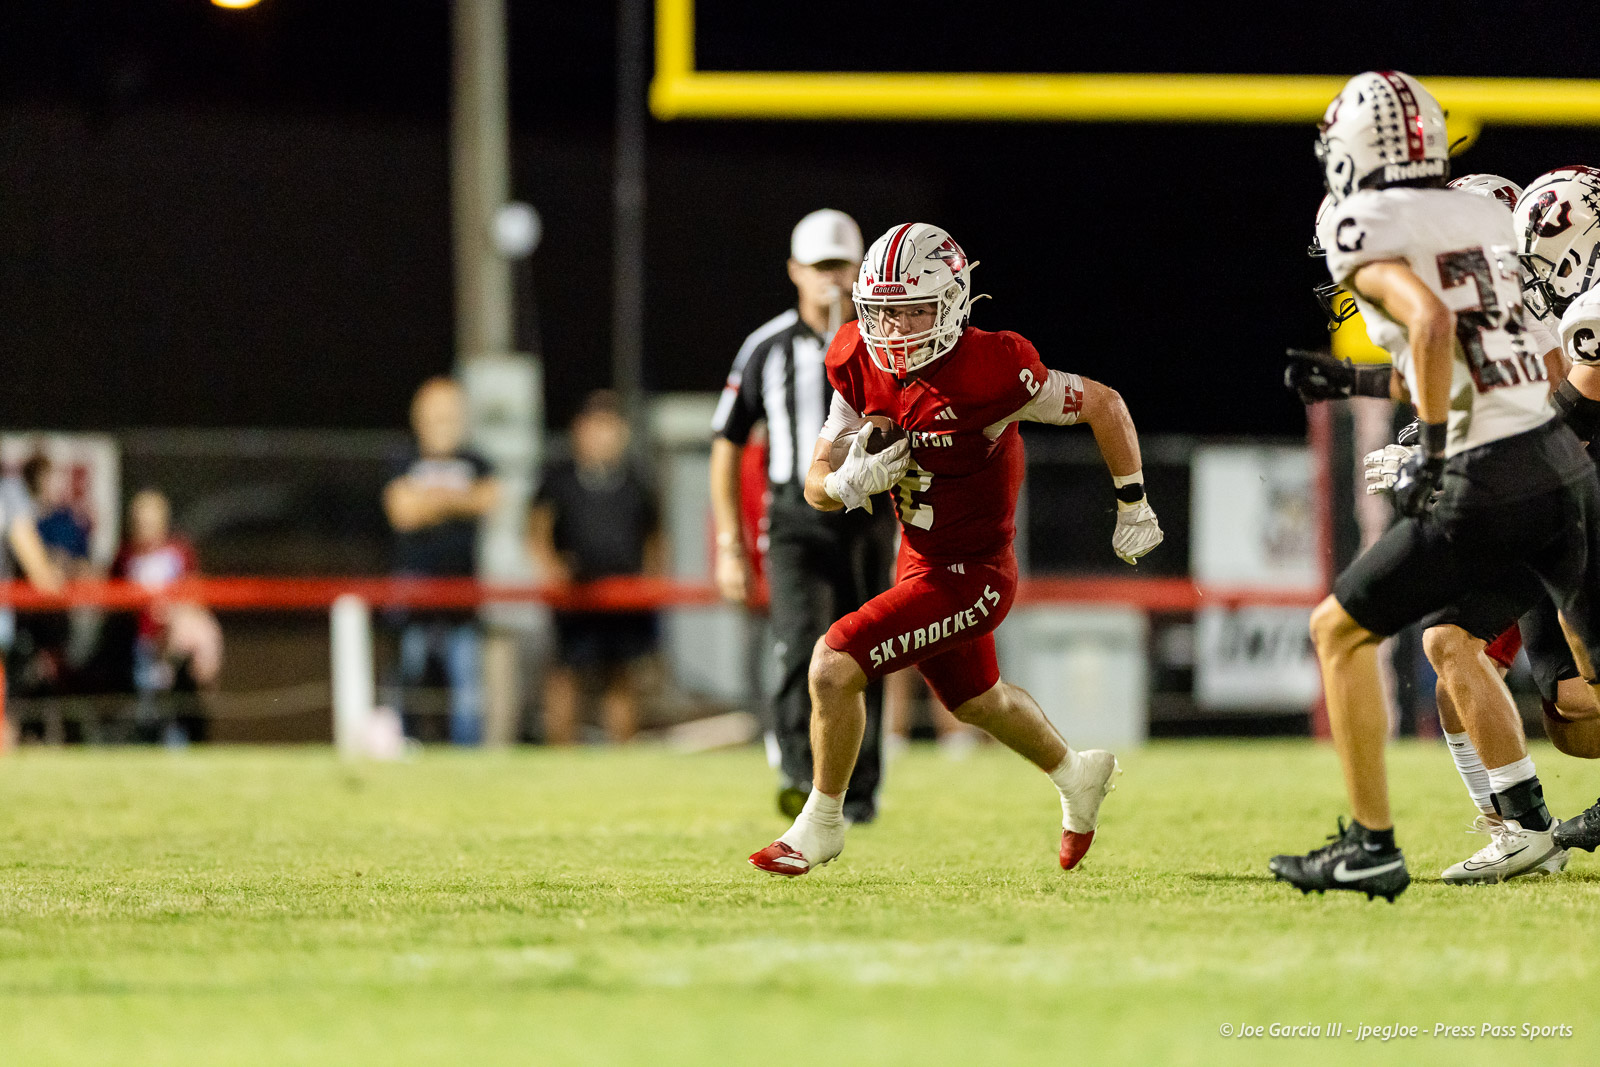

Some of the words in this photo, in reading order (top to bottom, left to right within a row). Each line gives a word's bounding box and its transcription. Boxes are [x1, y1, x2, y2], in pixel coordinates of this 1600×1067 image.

[1384, 160, 1444, 182] Riddell
[1018, 368, 1041, 397] 2
[869, 584, 1001, 669] SKYROCKETS
